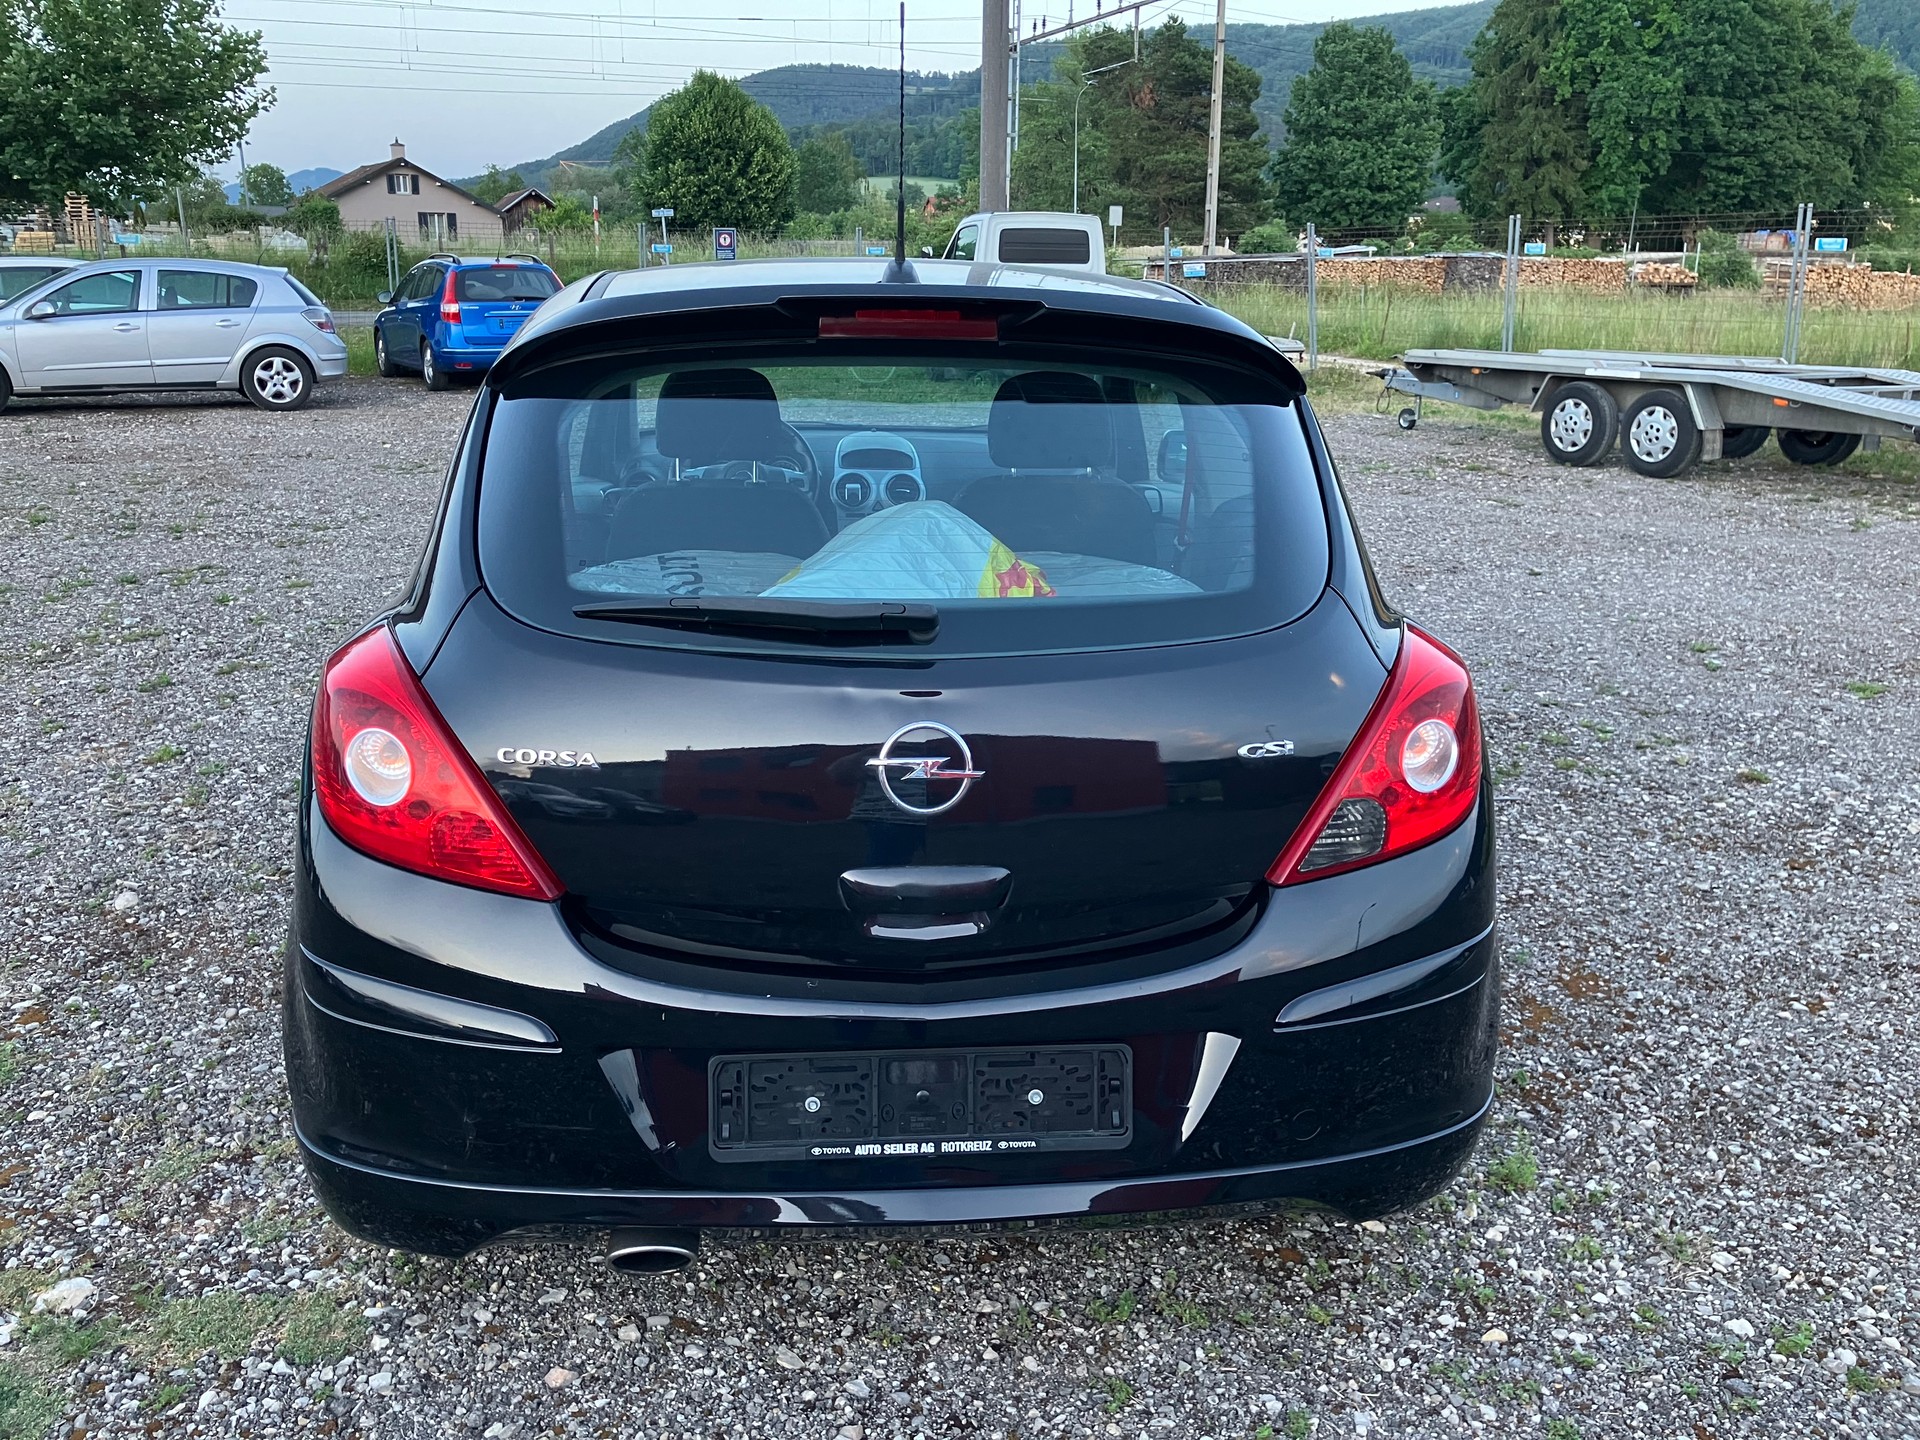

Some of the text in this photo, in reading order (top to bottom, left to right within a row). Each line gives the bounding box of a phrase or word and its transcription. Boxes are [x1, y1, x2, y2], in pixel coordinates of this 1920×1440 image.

[497, 747, 600, 769] CORSA
[822, 1140, 1037, 1156] TOYOTA AUTO SEILER AG ROTKREUZ TOYOTA
